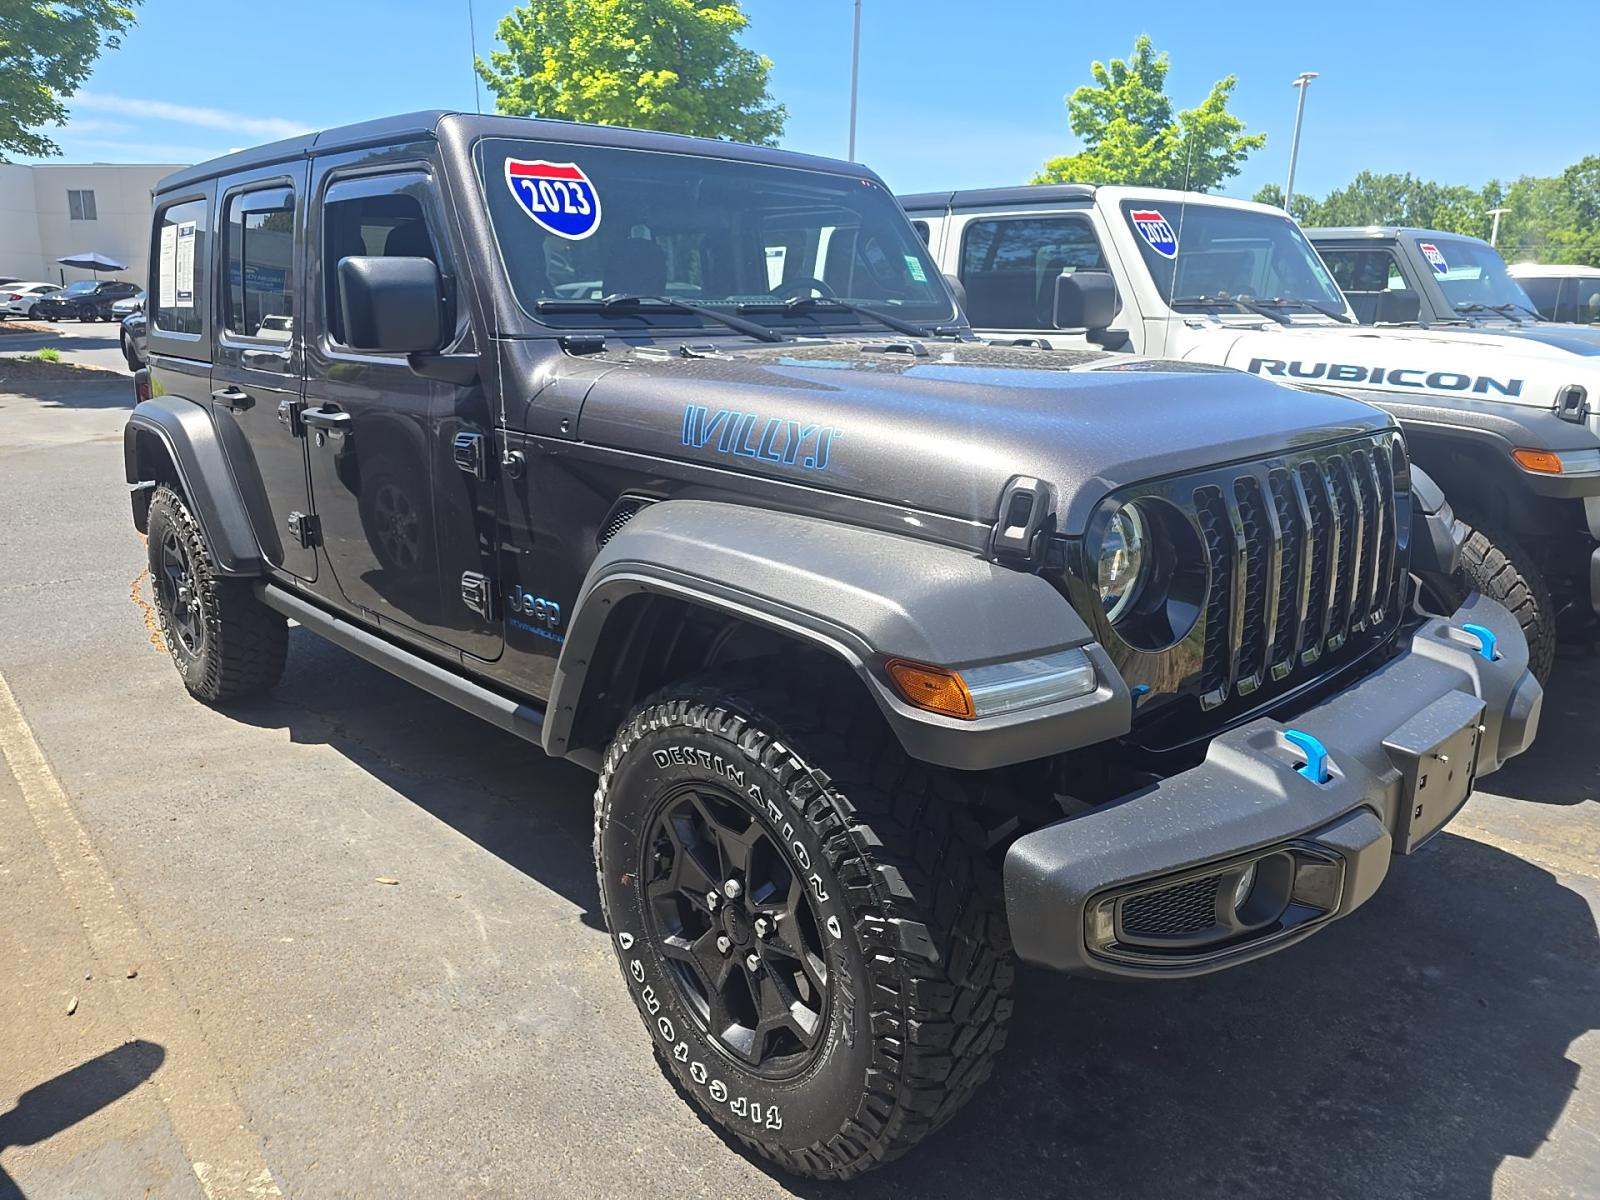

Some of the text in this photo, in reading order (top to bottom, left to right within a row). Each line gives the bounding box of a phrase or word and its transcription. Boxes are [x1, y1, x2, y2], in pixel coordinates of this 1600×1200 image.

[520, 179, 590, 215] 2023
[1140, 222, 1174, 243] 2023
[1247, 358, 1525, 397] RUBICON
[682, 404, 844, 470] WILLYS
[508, 585, 561, 629] Jeep
[652, 745, 830, 903] DESTINATION
